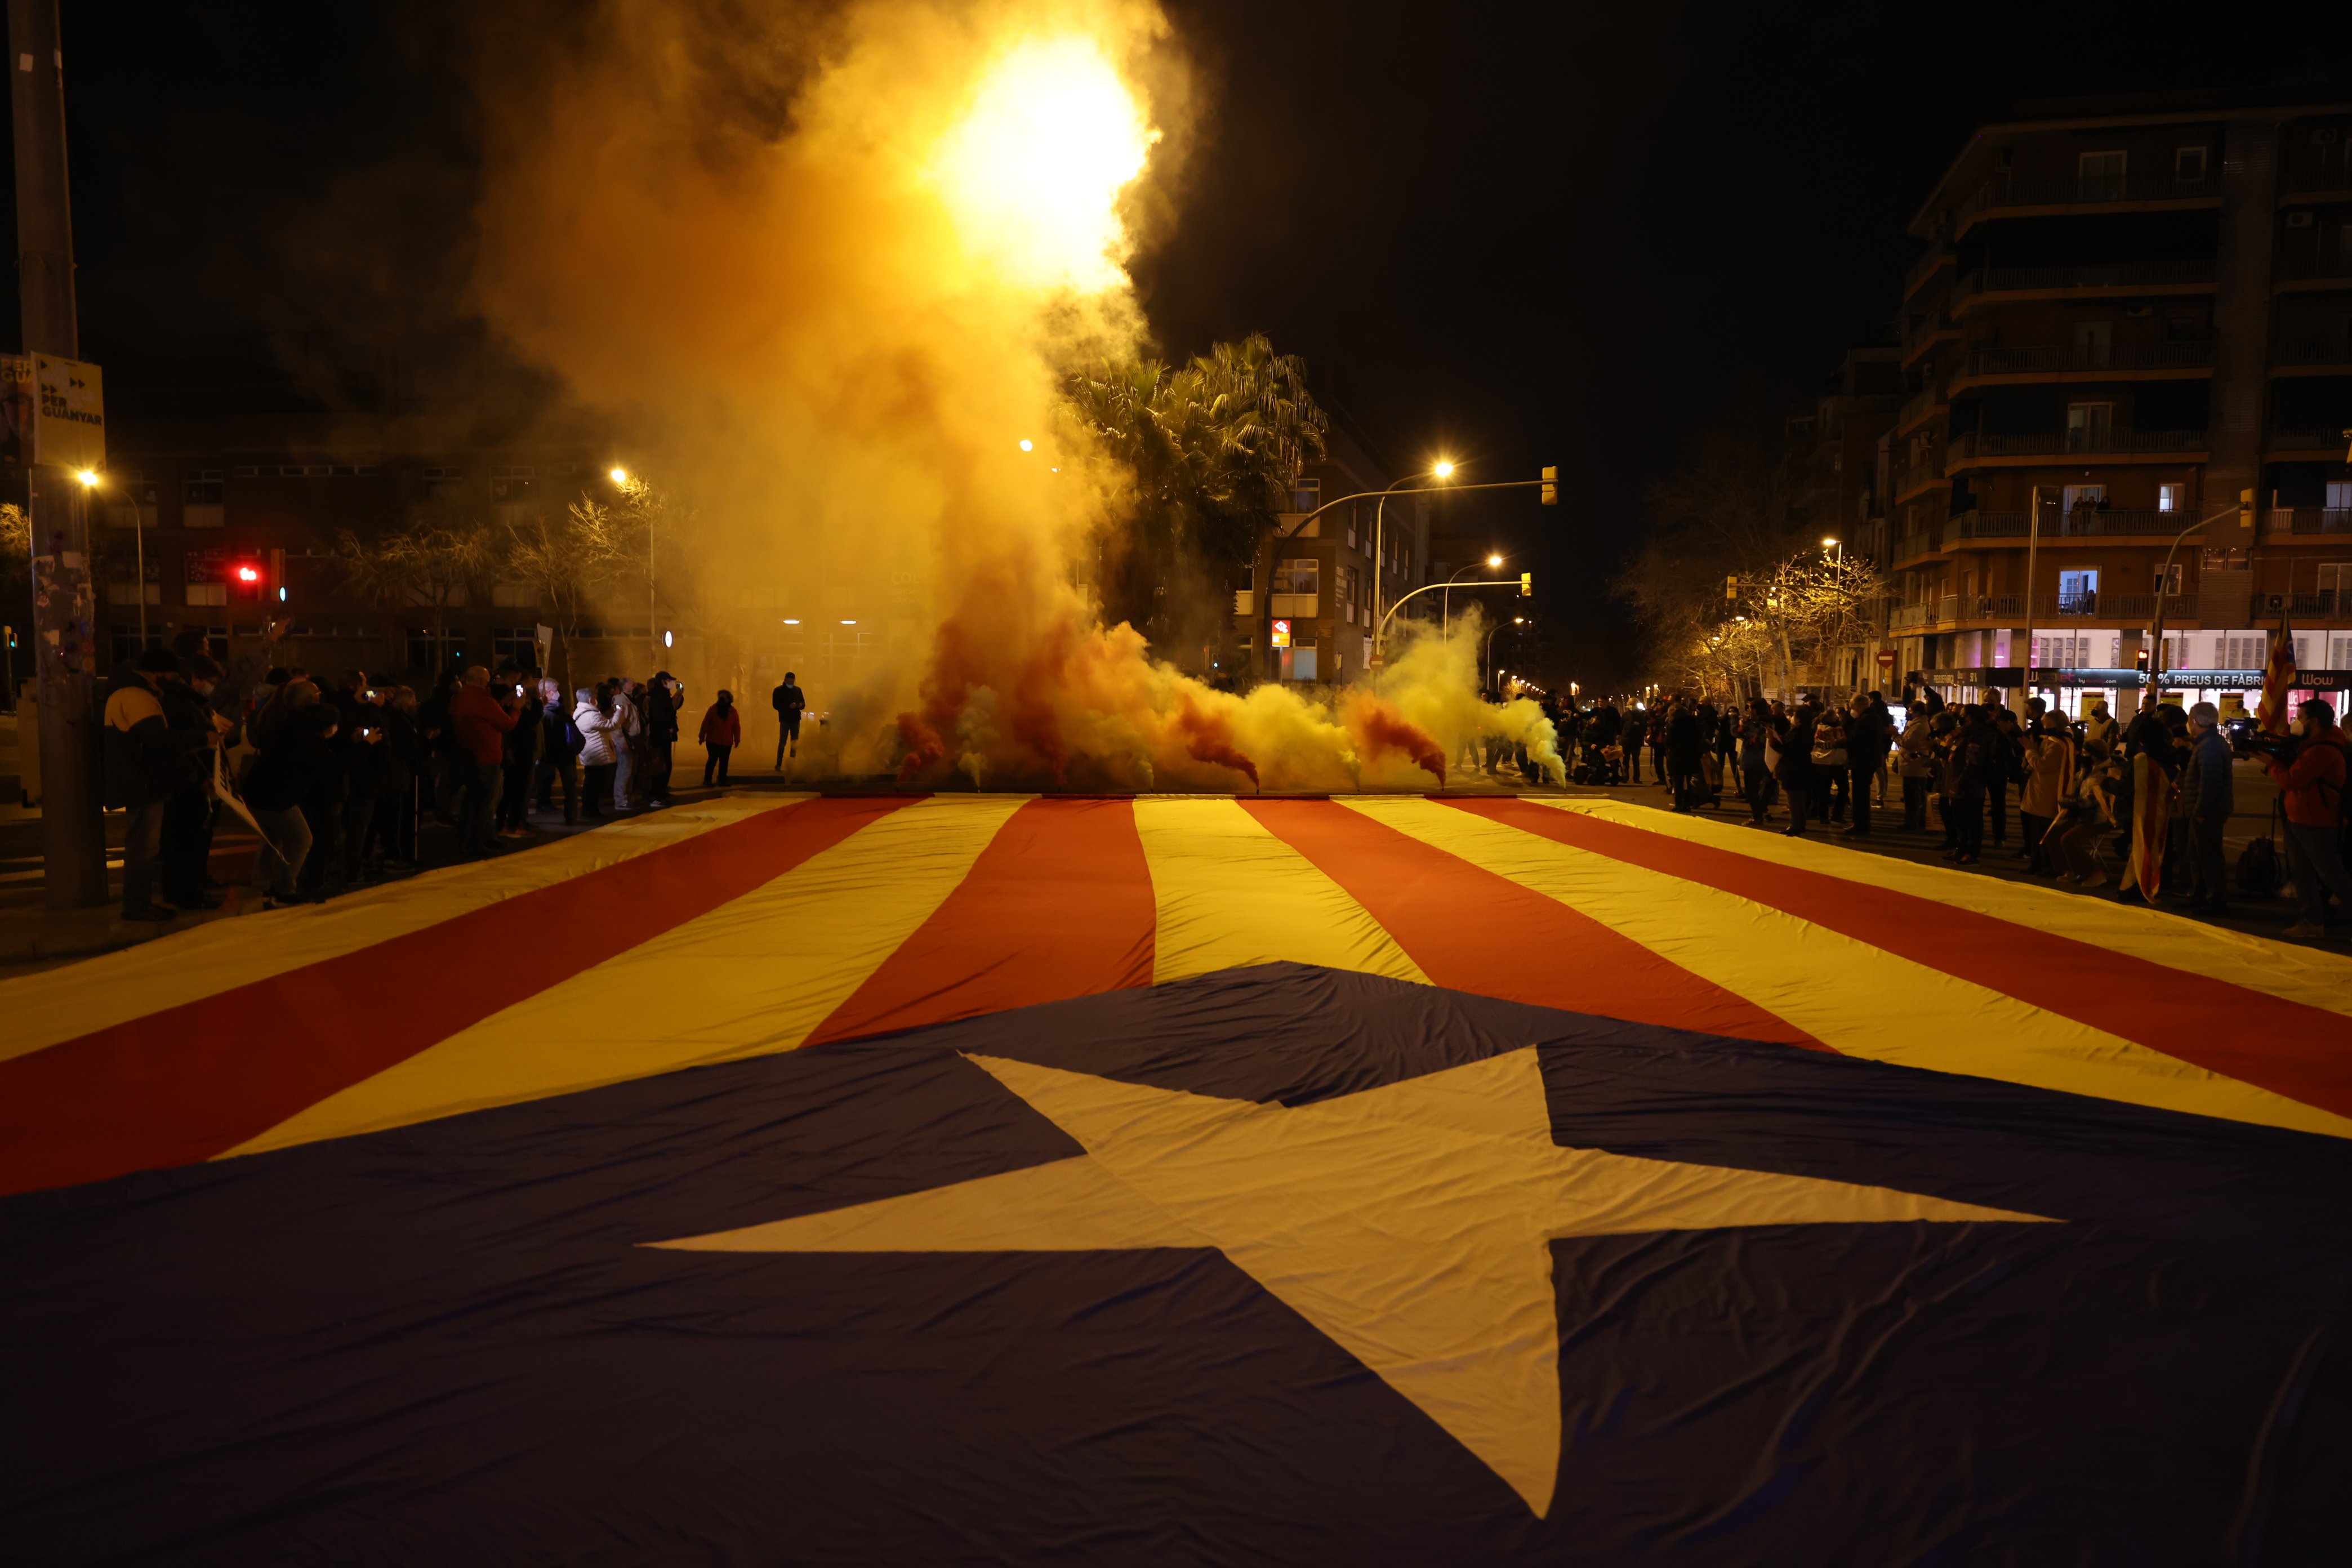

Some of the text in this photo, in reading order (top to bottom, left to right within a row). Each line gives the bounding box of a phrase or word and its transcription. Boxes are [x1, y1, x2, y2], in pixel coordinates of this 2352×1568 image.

[42, 394, 67, 408] PER
[42, 407, 102, 426] GUANYAR
[2175, 675, 2211, 685] PREUS
[2214, 675, 2229, 685] DE
[2301, 674, 2333, 685] Wow
